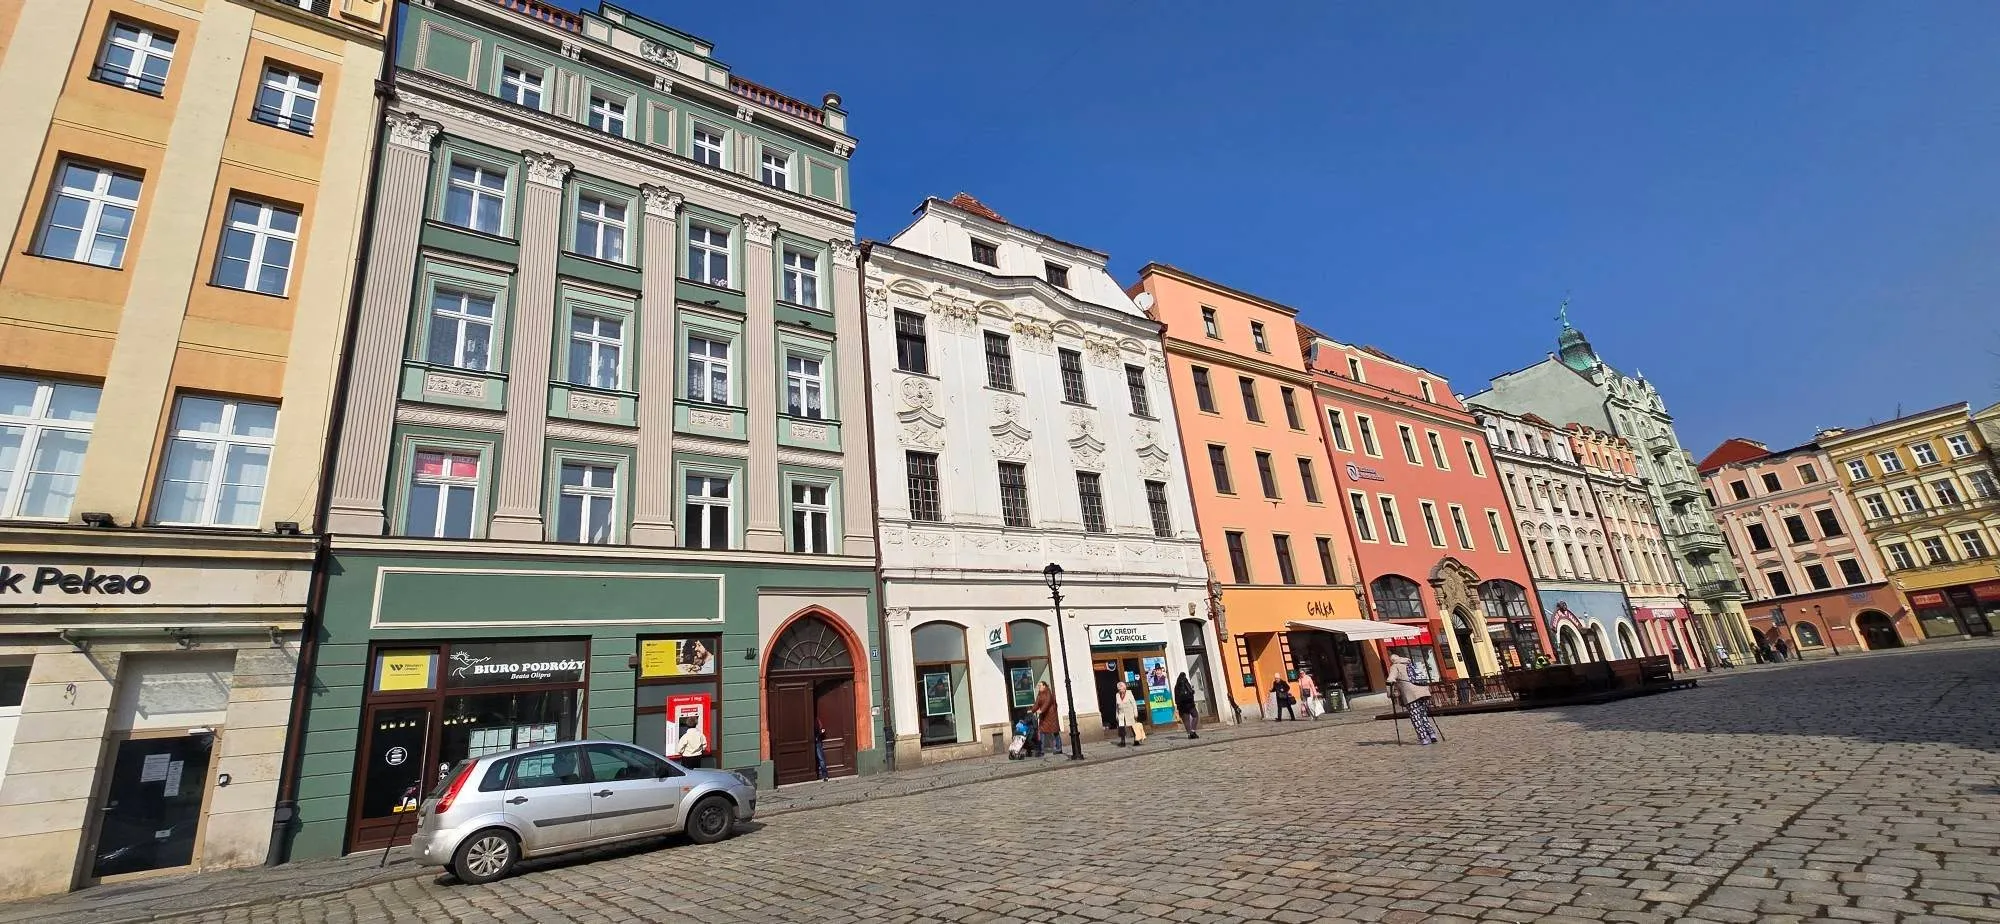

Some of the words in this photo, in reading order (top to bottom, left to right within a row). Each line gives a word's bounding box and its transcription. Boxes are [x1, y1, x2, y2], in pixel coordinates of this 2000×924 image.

[32, 566, 151, 595] Pekao
[474, 663, 519, 675] BIURO
[521, 659, 586, 673] PODRÓŻY
